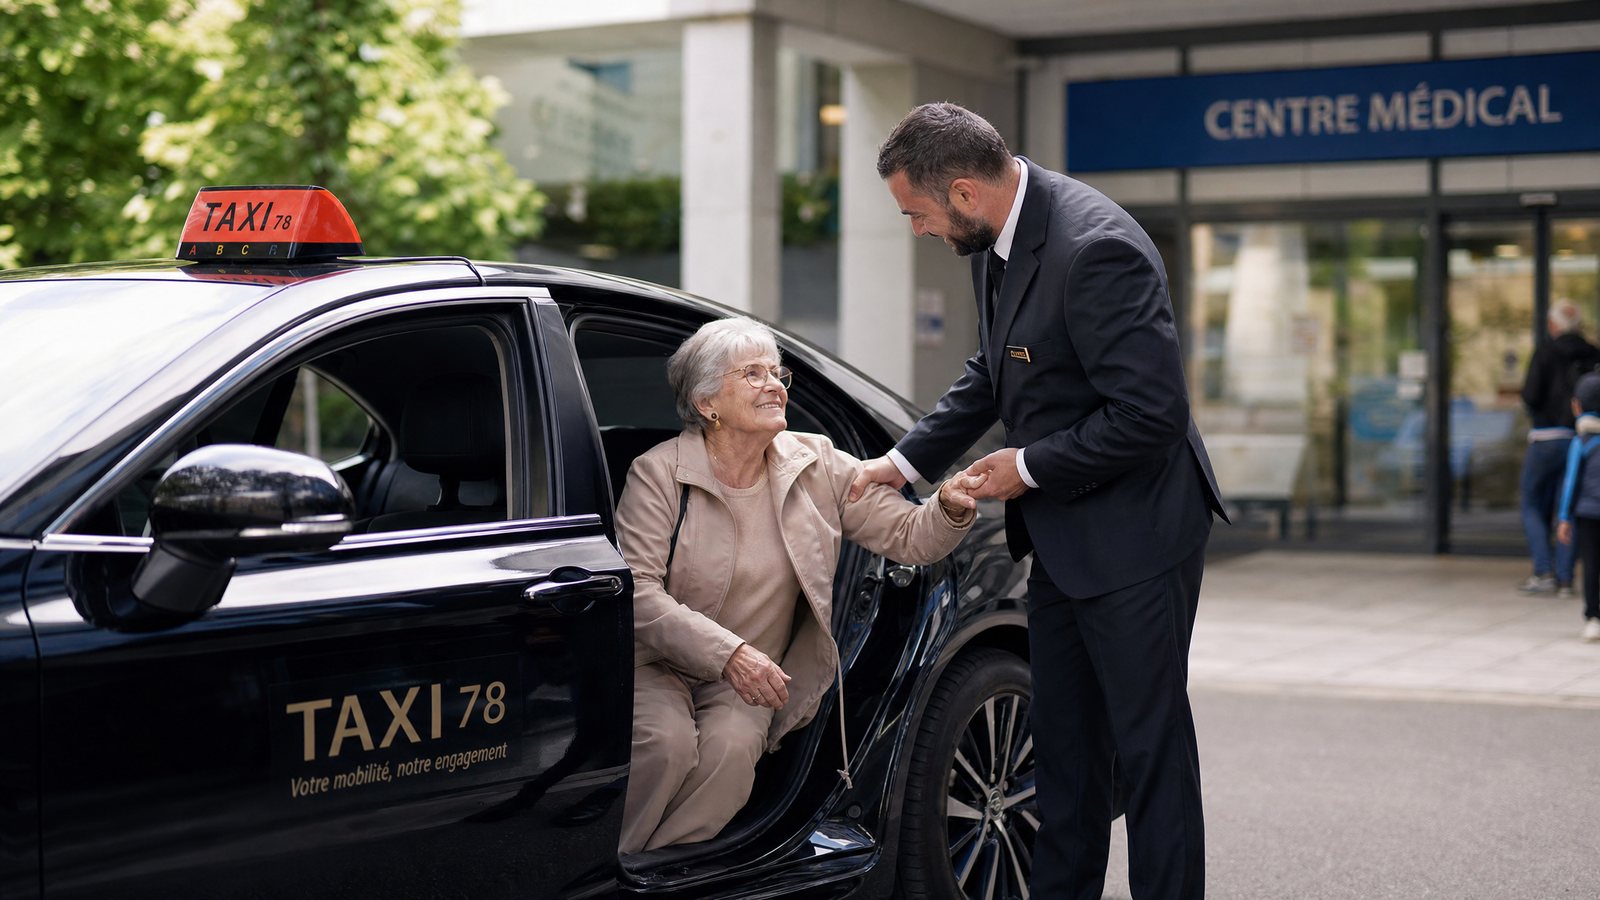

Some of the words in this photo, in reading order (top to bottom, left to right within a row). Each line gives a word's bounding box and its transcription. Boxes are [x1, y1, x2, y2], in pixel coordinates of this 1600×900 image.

[1205, 94, 1359, 140] CENTRE
[1368, 81, 1562, 132] MÉDICAL
[203, 202, 274, 232] TAXI
[273, 215, 292, 230] 78
[189, 245, 196, 256] A
[216, 245, 224, 256] B
[241, 245, 249, 255] C
[286, 683, 442, 761] TAXI
[459, 681, 506, 728] 78
[291, 777, 329, 798] Votre
[333, 761, 392, 790] mobilité,
[397, 757, 432, 778] notre
[435, 742, 508, 772] engagement
